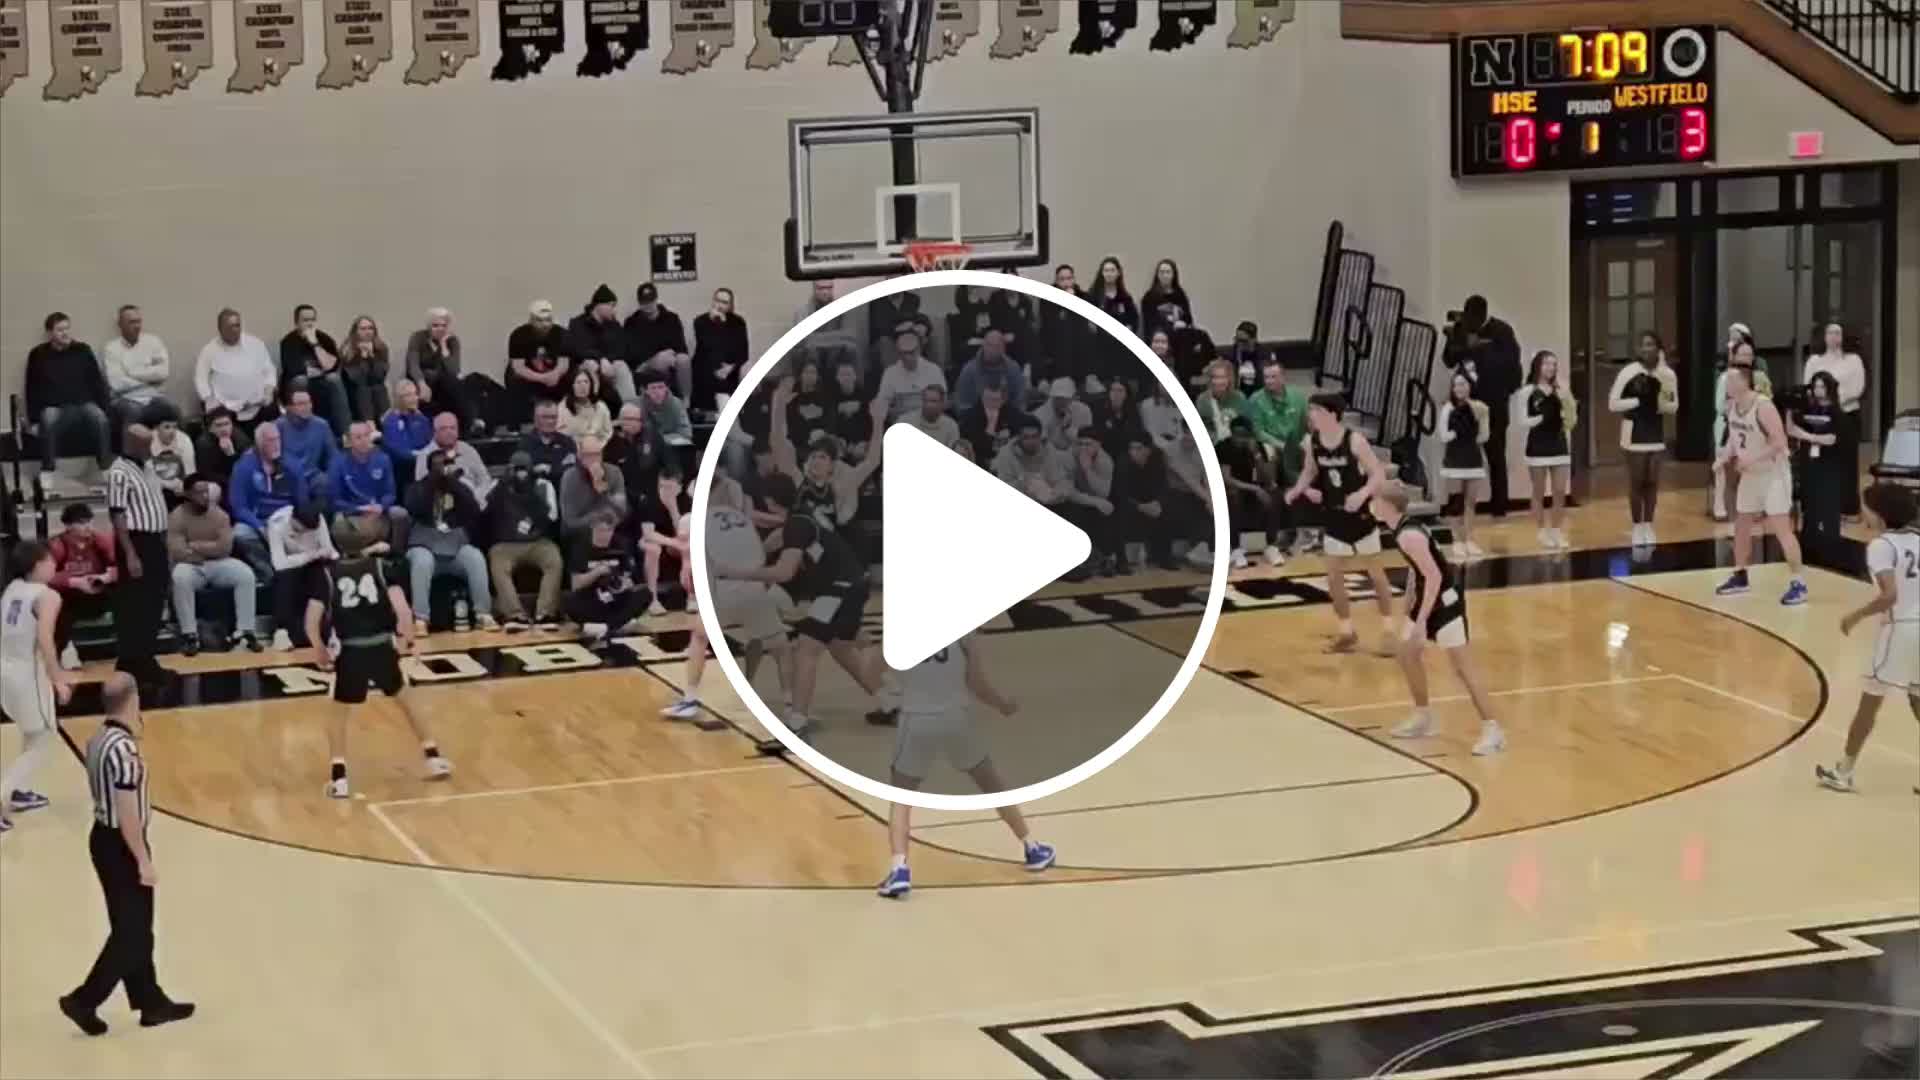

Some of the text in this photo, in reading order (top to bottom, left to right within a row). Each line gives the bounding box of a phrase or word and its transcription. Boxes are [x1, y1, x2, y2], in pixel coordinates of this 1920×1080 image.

[1470, 39, 1516, 86] N
[1559, 31, 1648, 79] 7:09
[1567, 99, 1612, 115] PERIOD
[1614, 82, 1708, 107] WESTFIELD
[1509, 118, 1536, 166] 0
[1586, 121, 1599, 153] 1
[1682, 108, 1706, 156] 3
[667, 246, 682, 270] E
[1904, 548, 1920, 579] 2
[337, 573, 379, 608] 24
